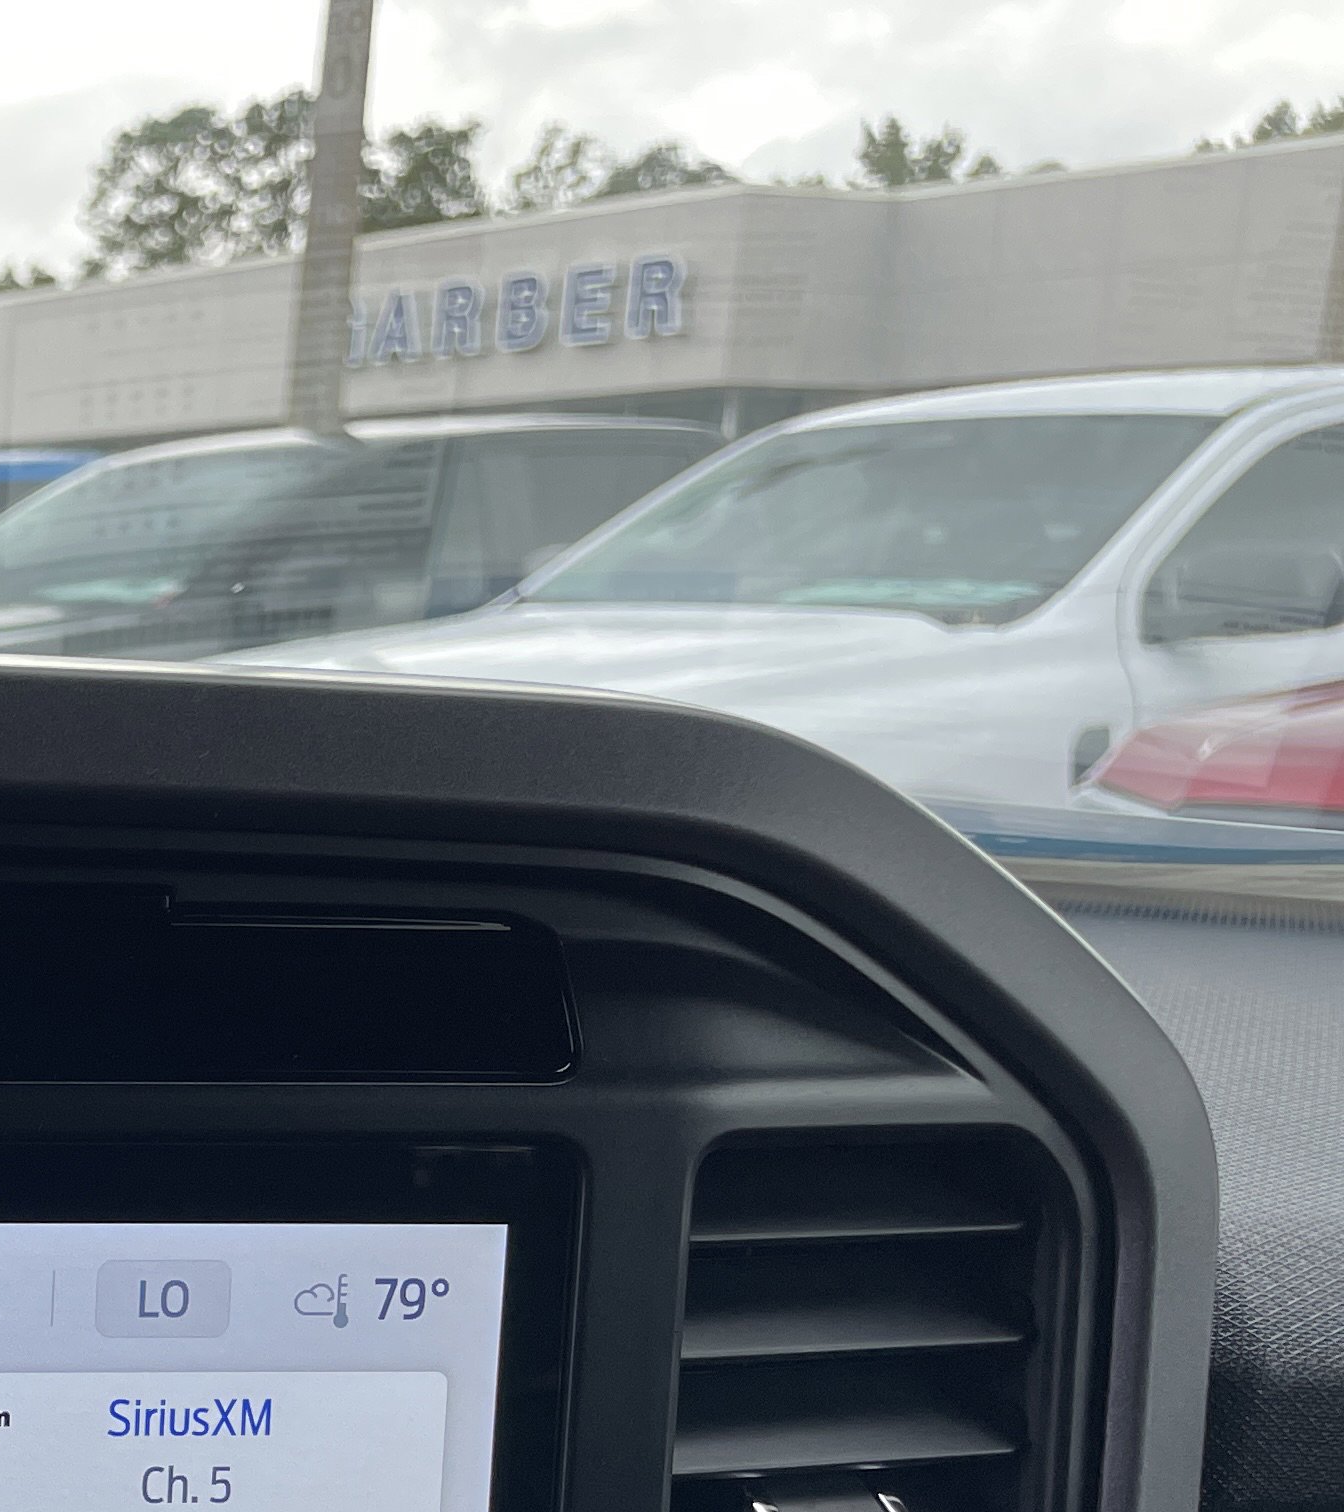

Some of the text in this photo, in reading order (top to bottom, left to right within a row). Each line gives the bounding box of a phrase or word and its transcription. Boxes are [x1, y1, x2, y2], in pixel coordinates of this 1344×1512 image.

[138, 1279, 190, 1319] LO
[374, 1277, 450, 1321] 79°
[107, 1398, 272, 1437] SiriusXM
[141, 1465, 232, 1504] Ch. 5
